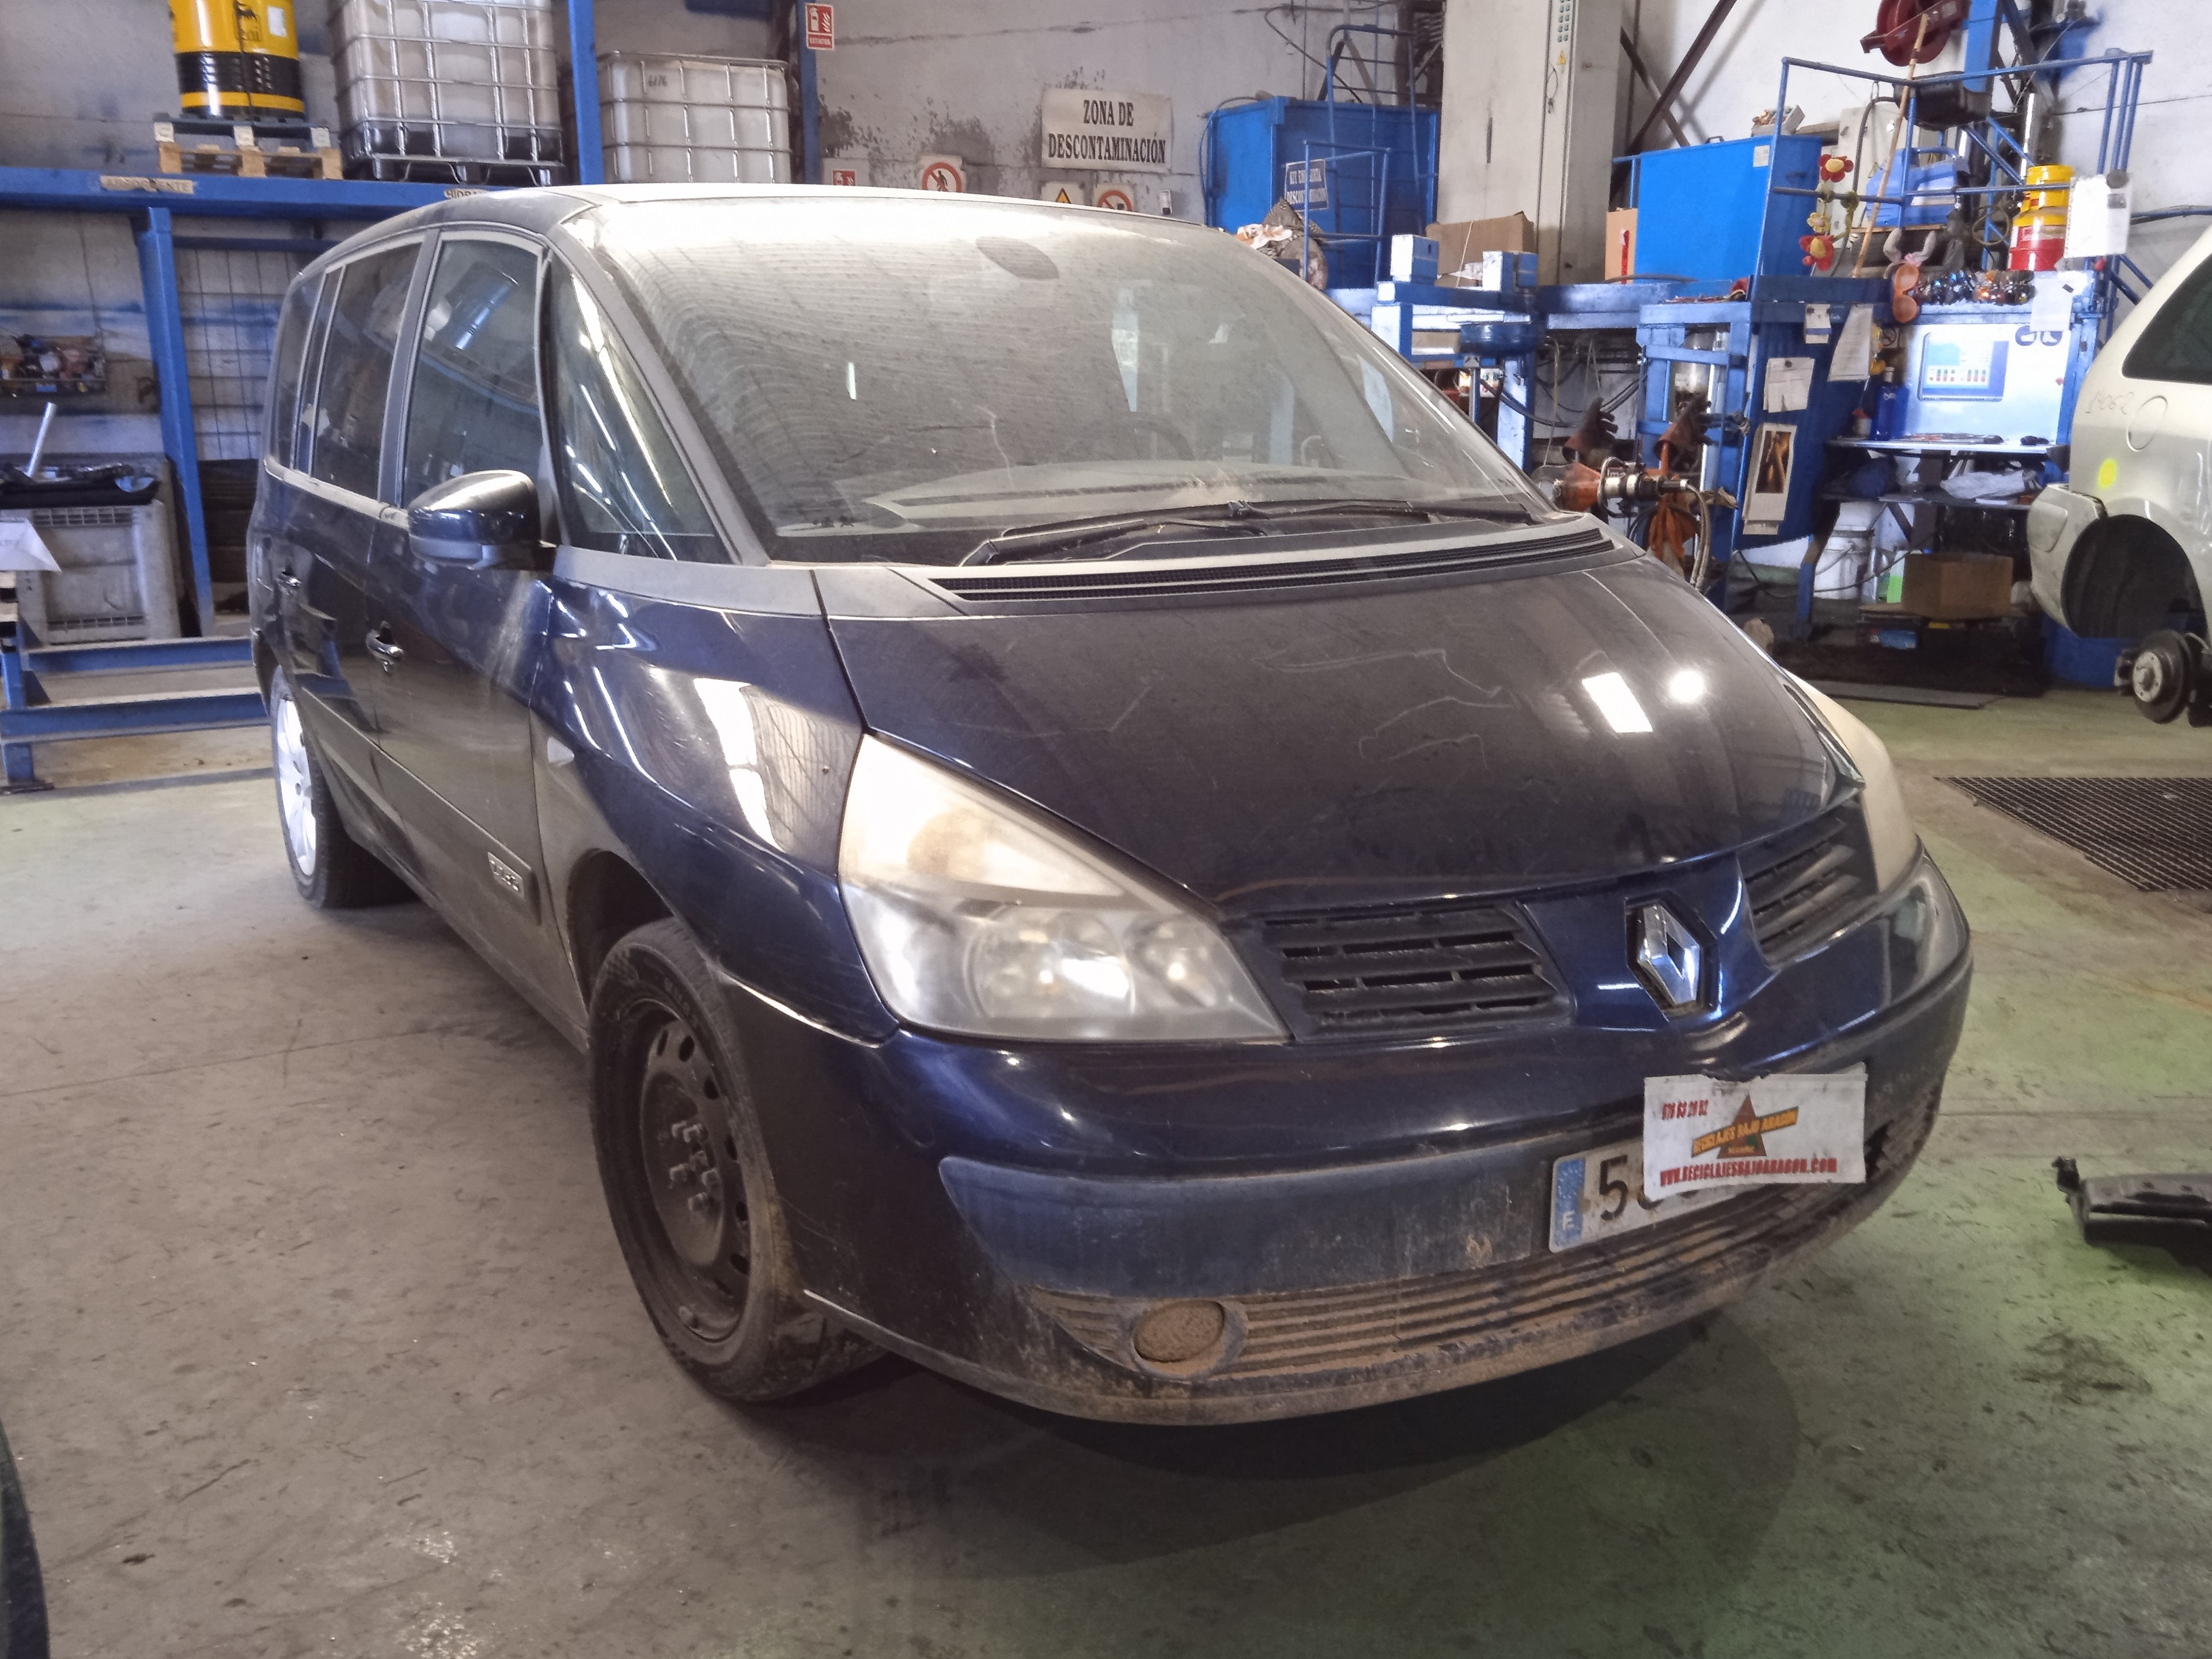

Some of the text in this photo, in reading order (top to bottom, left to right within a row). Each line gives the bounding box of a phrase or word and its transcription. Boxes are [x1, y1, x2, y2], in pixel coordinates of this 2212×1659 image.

[1084, 100, 1134, 126] ZONA DE
[1048, 131, 1165, 164] DESCONTAMINACIÓN
[1562, 1210, 1575, 1231] E
